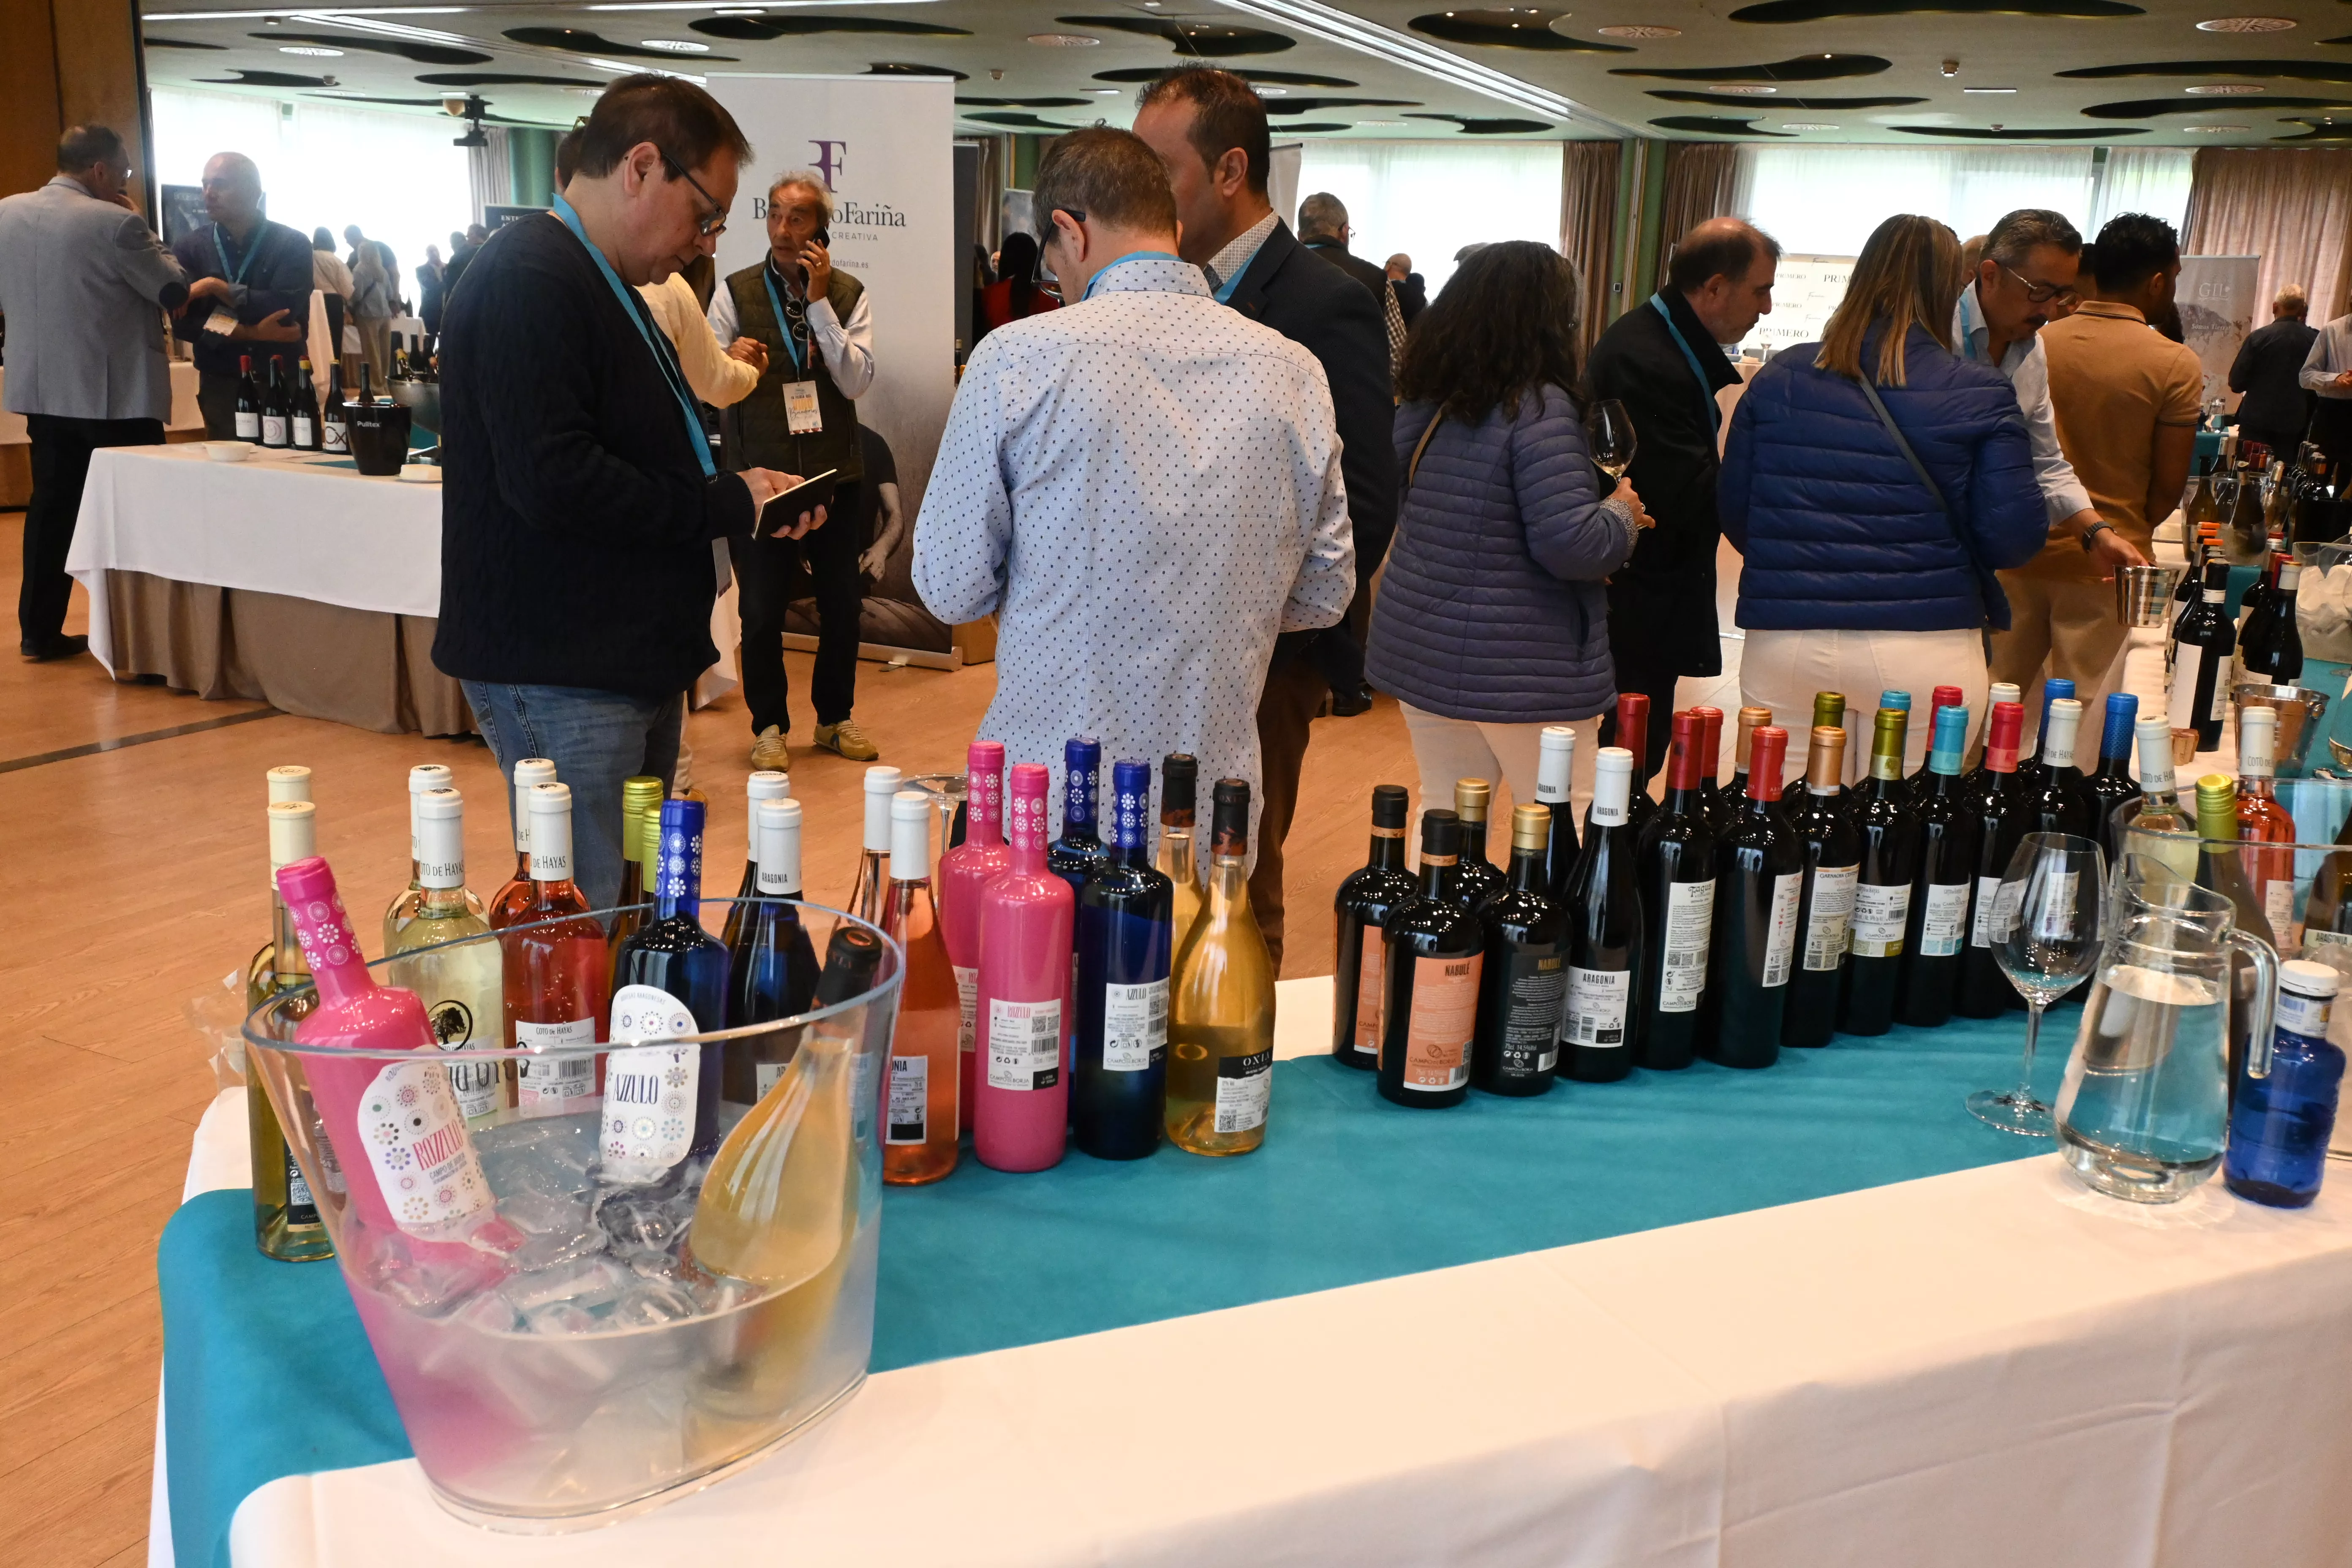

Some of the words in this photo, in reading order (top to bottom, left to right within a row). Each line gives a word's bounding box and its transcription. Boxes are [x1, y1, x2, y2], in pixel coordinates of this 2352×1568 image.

[832, 231, 878, 241] CREATIVA
[1824, 274, 1850, 283] PRIM
[2248, 756, 2263, 767] COTO
[1538, 783, 1557, 794] ARAGONIA
[1597, 806, 1619, 817] ARAGONIA
[533, 858, 541, 868] DE
[542, 855, 566, 869] HAYAS
[433, 866, 443, 876] DE
[762, 871, 788, 884] ARAGONIA
[1688, 883, 1712, 897] Fagus
[1445, 961, 1470, 977] NABULÉ
[1583, 973, 1615, 985] ARAGONIA
[1126, 988, 1147, 1001] AZZULO
[536, 1027, 548, 1035] COTO
[556, 1026, 573, 1035] HAYAS
[612, 1073, 659, 1105] AZZULO
[412, 1119, 464, 1171] ROZZULO
